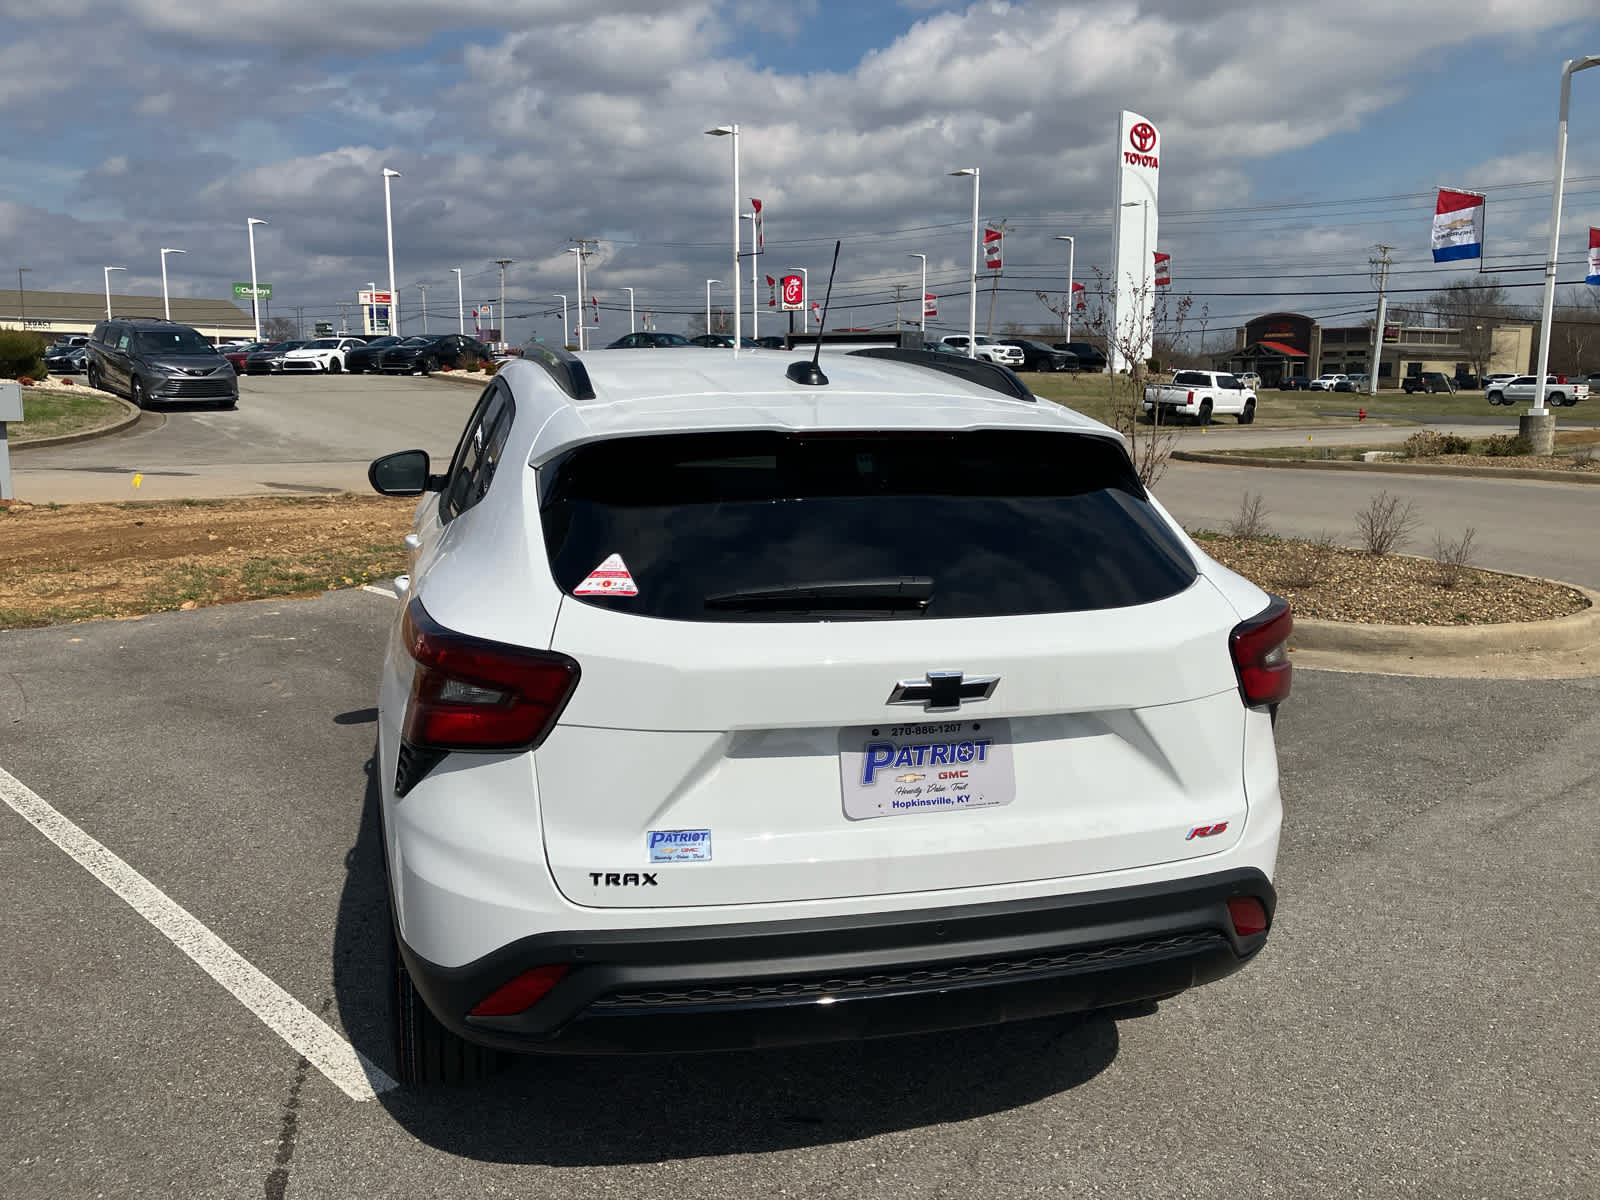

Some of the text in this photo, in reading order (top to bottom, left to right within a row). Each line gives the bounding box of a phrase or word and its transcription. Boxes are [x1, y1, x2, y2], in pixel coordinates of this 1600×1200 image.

[1124, 152, 1158, 169] TOYOTA
[891, 723, 962, 737] 270-886-1207
[861, 739, 992, 785] PATRIOT
[938, 769, 969, 780] GMC
[892, 796, 954, 809] Hopkinsville,
[957, 794, 970, 804] KY
[650, 832, 708, 849] PATRIOT
[589, 872, 658, 887] TRAX
